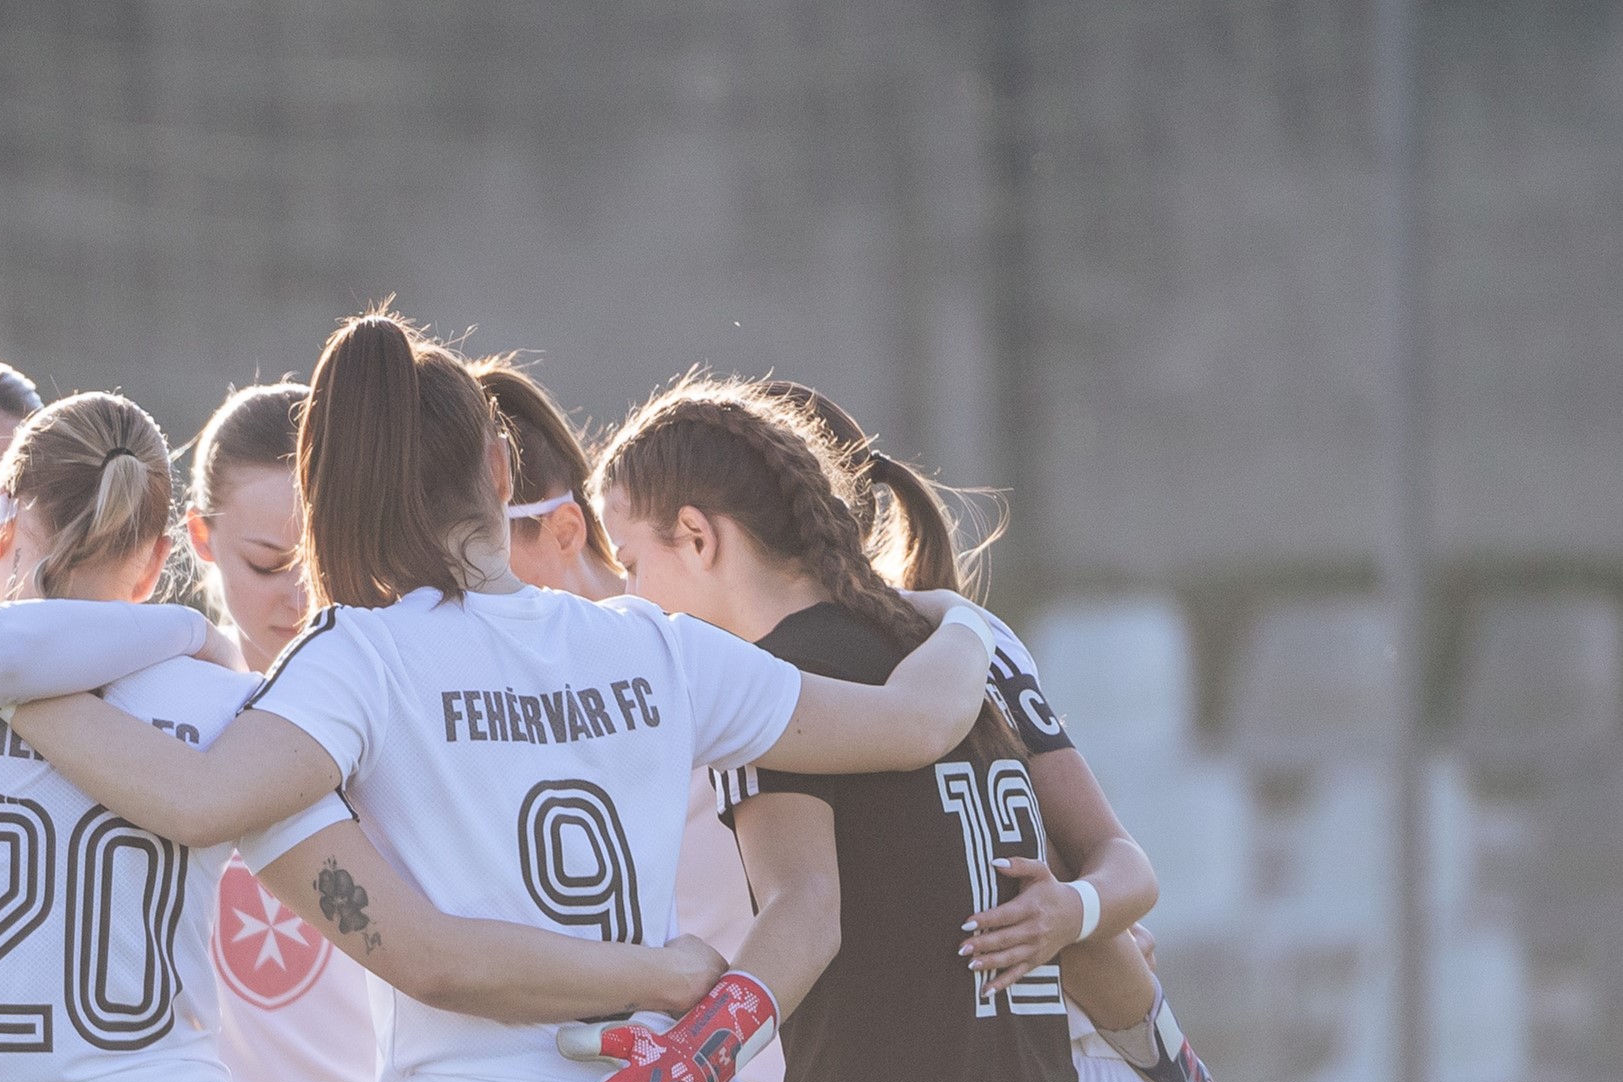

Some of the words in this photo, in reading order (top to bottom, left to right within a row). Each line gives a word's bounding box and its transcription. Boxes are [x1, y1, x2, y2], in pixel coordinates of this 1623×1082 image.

[609, 676, 661, 732] FC
[1018, 688, 1061, 736] C
[517, 778, 643, 945] 9
